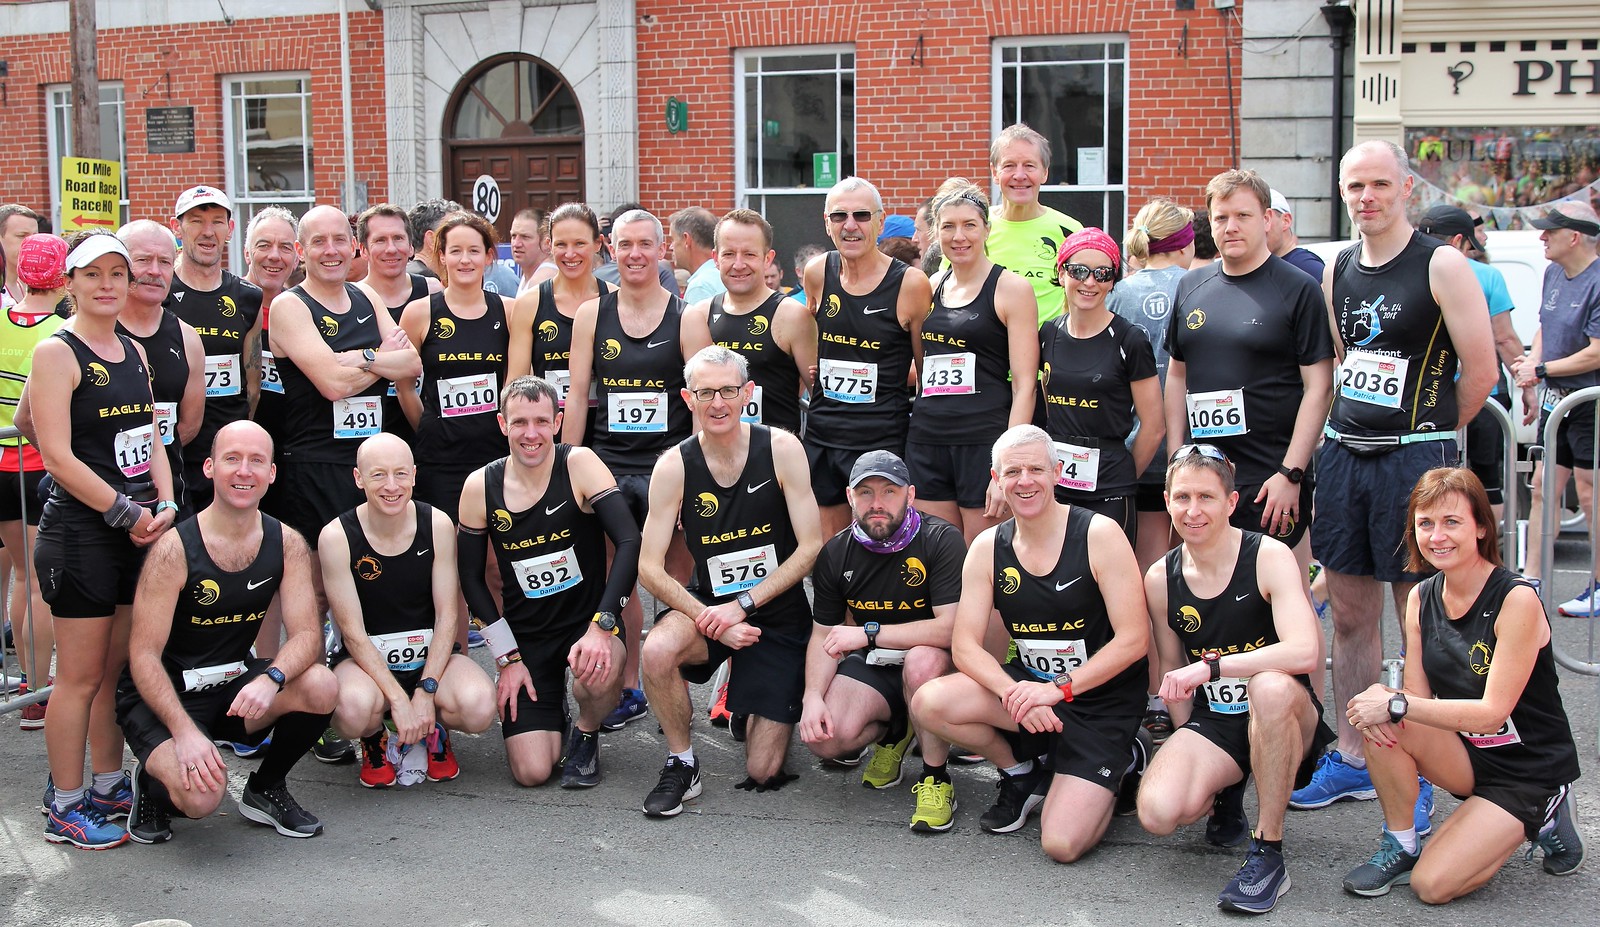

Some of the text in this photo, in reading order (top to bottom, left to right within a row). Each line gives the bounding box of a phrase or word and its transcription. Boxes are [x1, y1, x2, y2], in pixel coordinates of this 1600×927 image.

[76, 162, 112, 176] 10 Mile
[66, 179, 117, 195] Road Race
[72, 198, 113, 214] Race HQ
[477, 182, 499, 217] 80
[1150, 302, 1164, 314] 10
[195, 328, 239, 339] GLE AC
[823, 332, 880, 350] EAGLE AC
[921, 332, 966, 348] AGLE AC
[742, 342, 763, 350] AC
[438, 353, 502, 362] EAGLE AC
[544, 352, 570, 360] EAG
[602, 378, 664, 388] EAGLE AC
[822, 376, 872, 394] 1775
[927, 369, 963, 386] 433
[1342, 369, 1398, 396] 2036
[443, 388, 495, 409] 1010
[1079, 399, 1098, 408] AC
[1354, 391, 1376, 400] Patrick
[99, 404, 141, 417] EAGLE
[618, 408, 656, 423] 197
[1190, 408, 1240, 428] 1066
[344, 412, 377, 428] 491
[502, 529, 571, 550] EAGLE AC
[702, 524, 771, 544] EAGLE AC
[526, 567, 571, 590] 892
[721, 562, 767, 584] 576
[540, 584, 565, 595] Damian
[847, 600, 893, 610] EAGLE
[191, 610, 266, 626] EAGLE AC
[1012, 618, 1085, 632] EAGLE AC
[1191, 636, 1266, 656] ELE AC
[387, 645, 428, 664] 694
